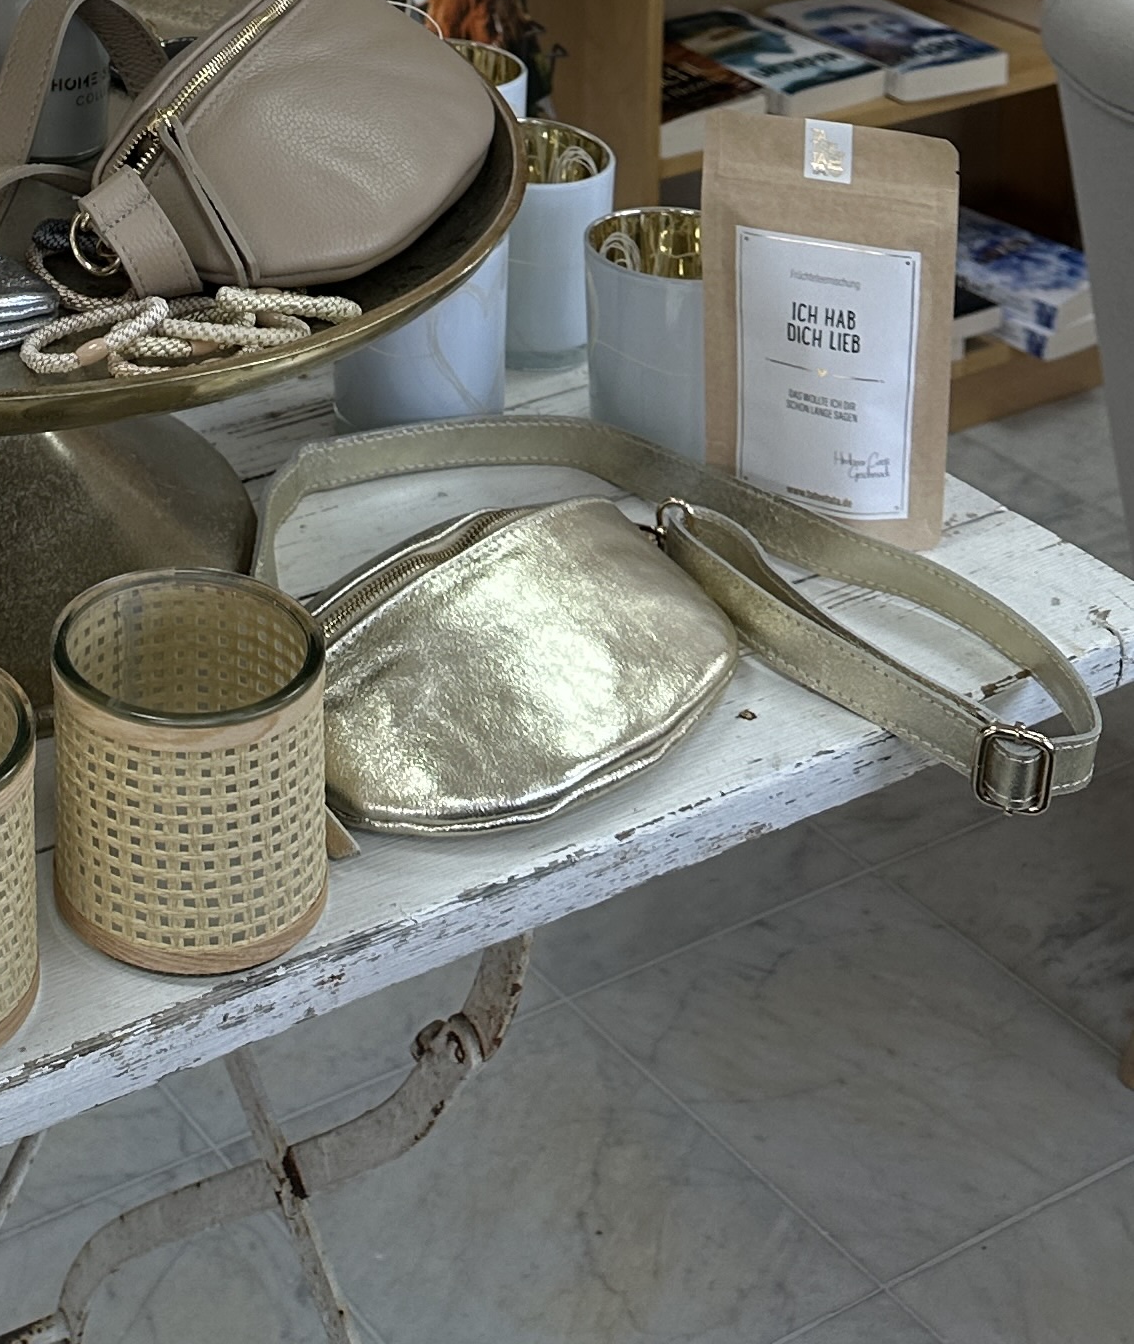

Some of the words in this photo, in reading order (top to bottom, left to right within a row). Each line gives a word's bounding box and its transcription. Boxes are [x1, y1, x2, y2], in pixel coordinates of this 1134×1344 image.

[51, 71, 98, 91] HOME
[792, 301, 818, 324] ICH
[825, 307, 856, 330] HAB
[787, 322, 823, 348] DICH
[829, 330, 861, 353] LIEB
[786, 399, 809, 413] SCHON
